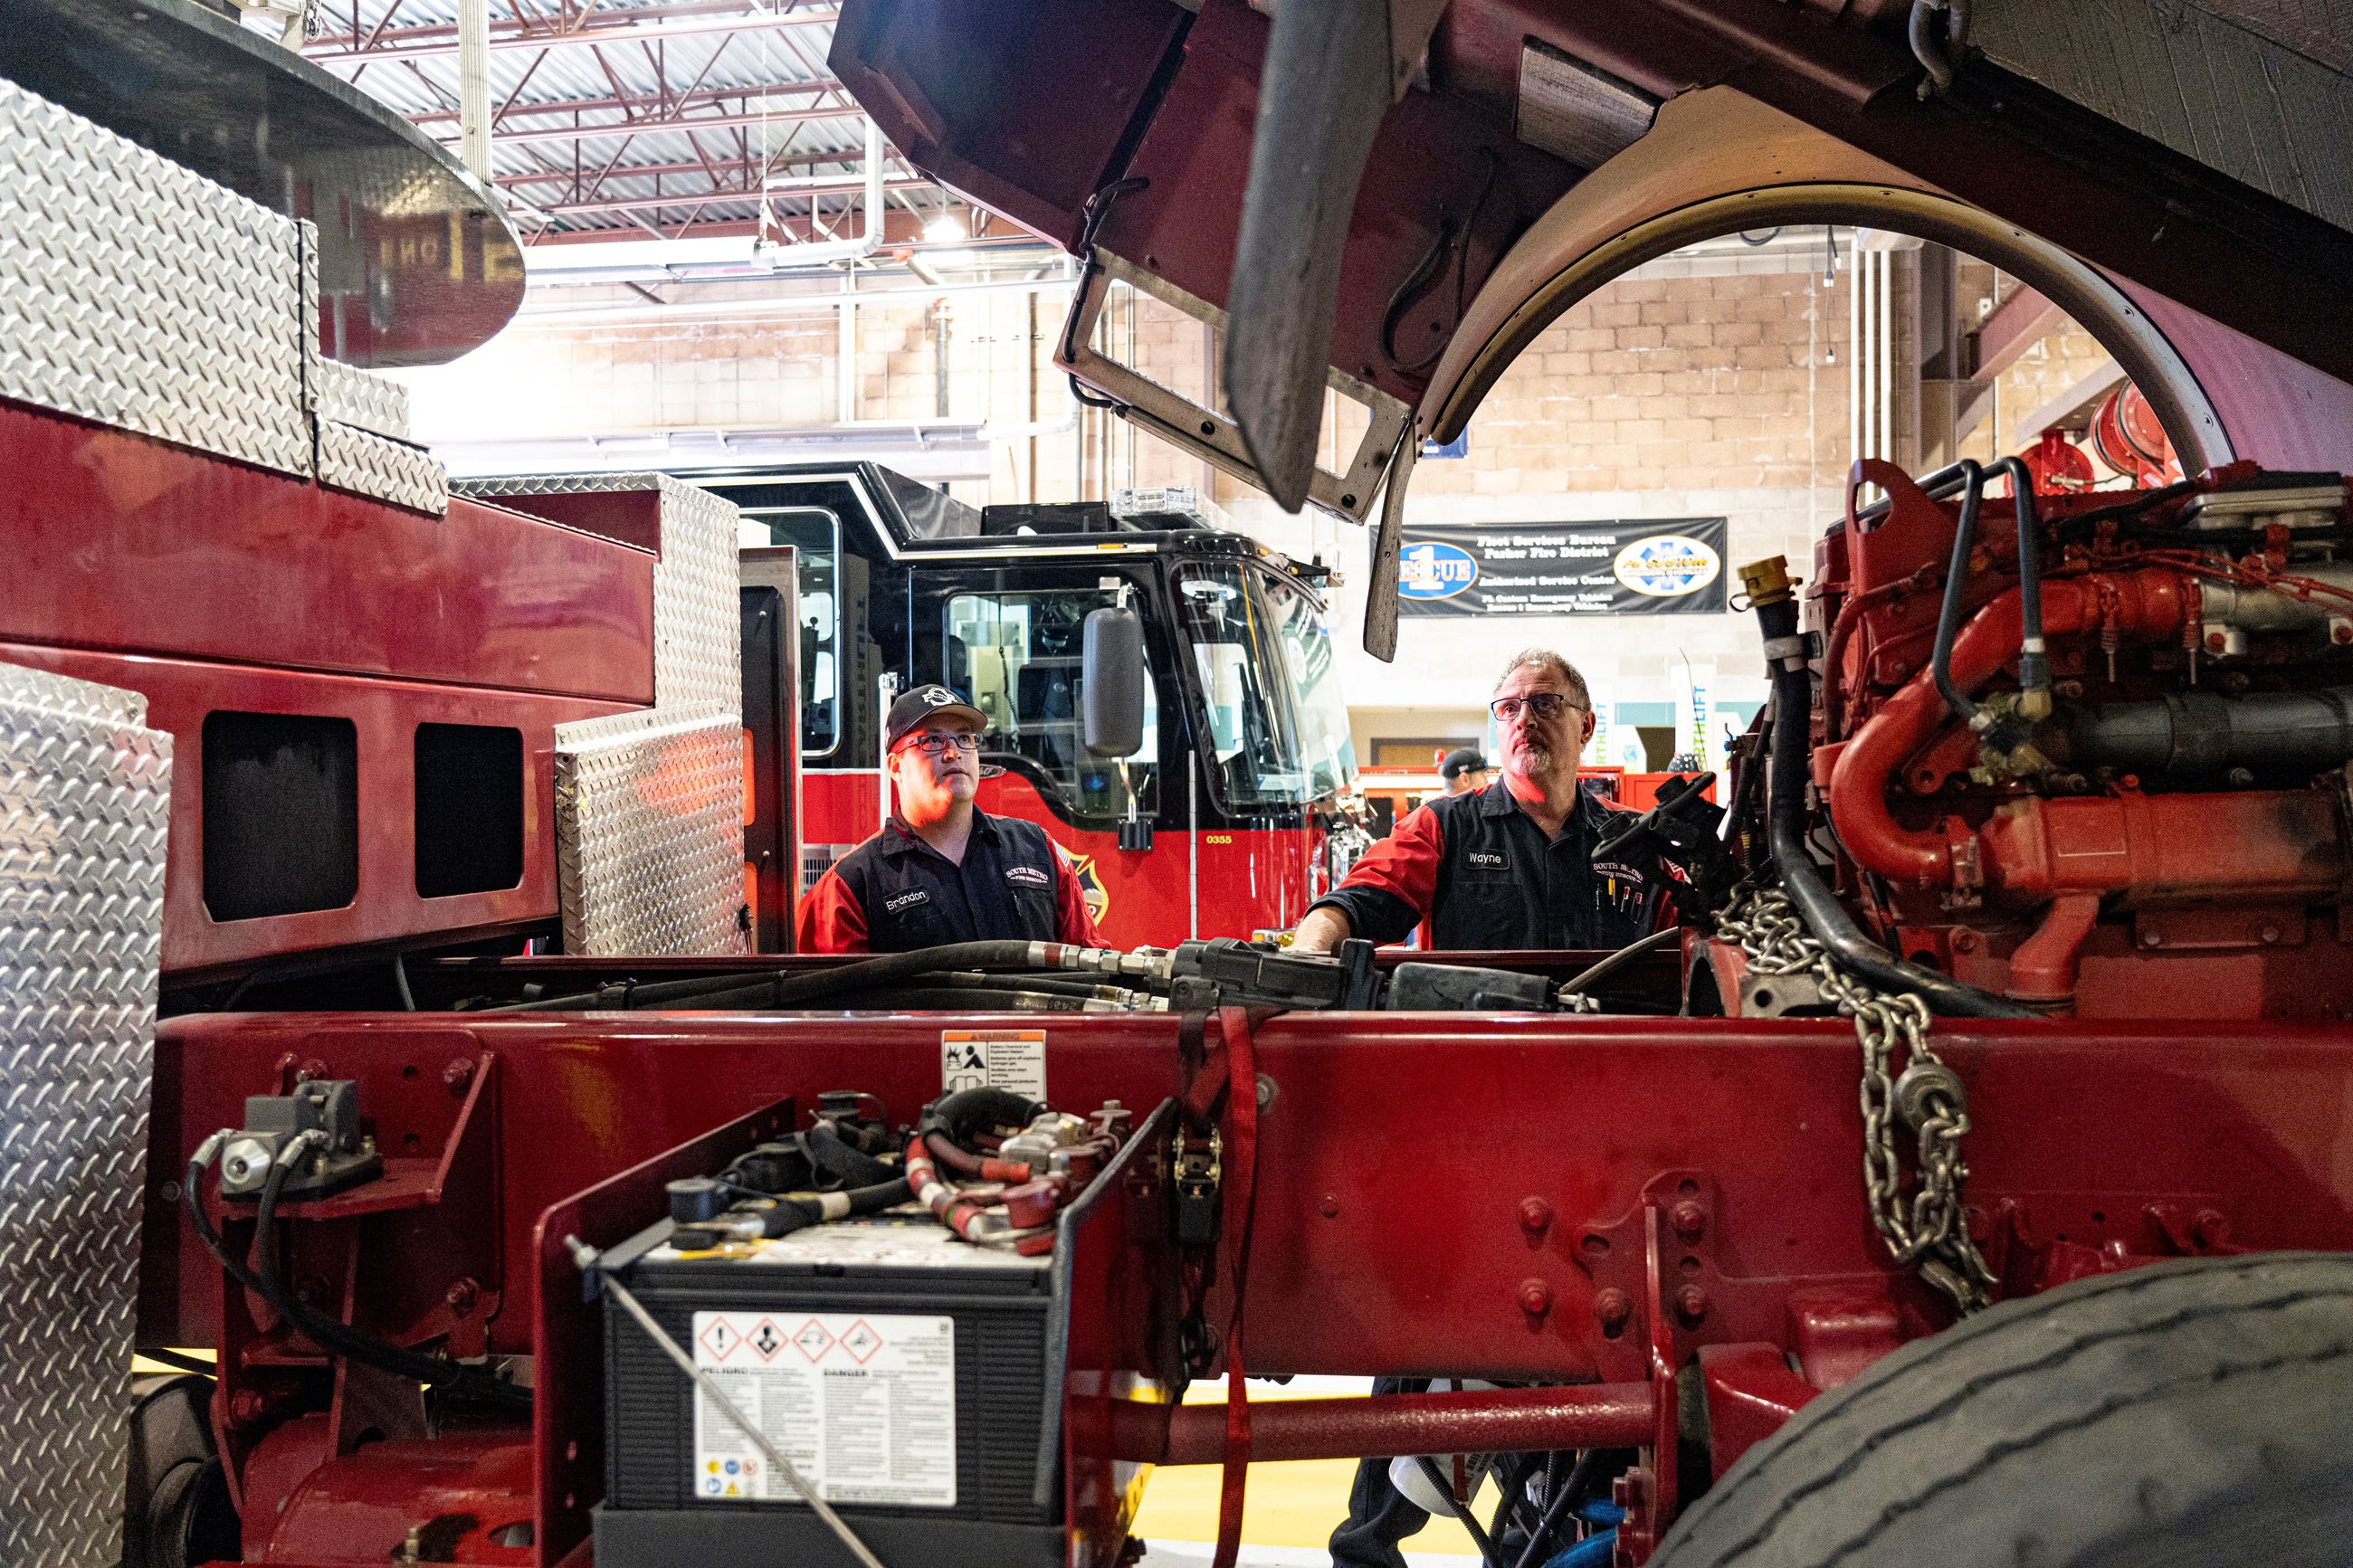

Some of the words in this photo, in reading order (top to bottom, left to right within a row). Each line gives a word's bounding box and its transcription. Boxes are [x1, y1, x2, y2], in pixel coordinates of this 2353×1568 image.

[1477, 536, 1510, 546] Fleet
[1513, 535, 1566, 546] Services
[1569, 534, 1616, 545] Bureau
[1484, 548, 1527, 559] Parker
[1529, 547, 1557, 558] Fire
[1559, 546, 1609, 557] District
[1399, 559, 1471, 582] ESCUE
[1479, 576, 1537, 586] Authorized
[1538, 575, 1578, 585] Service
[1580, 575, 1616, 584] Center
[1596, 702, 1607, 765] RTHLIFT
[1206, 835, 1233, 844] 0355
[1469, 852, 1501, 865] Wayne
[1593, 861, 1618, 870] SOUTH
[1005, 867, 1027, 878] SOUTH
[1027, 867, 1049, 880] METRO
[886, 890, 927, 911] Brandon
[824, 1369, 869, 1377] DANGER
